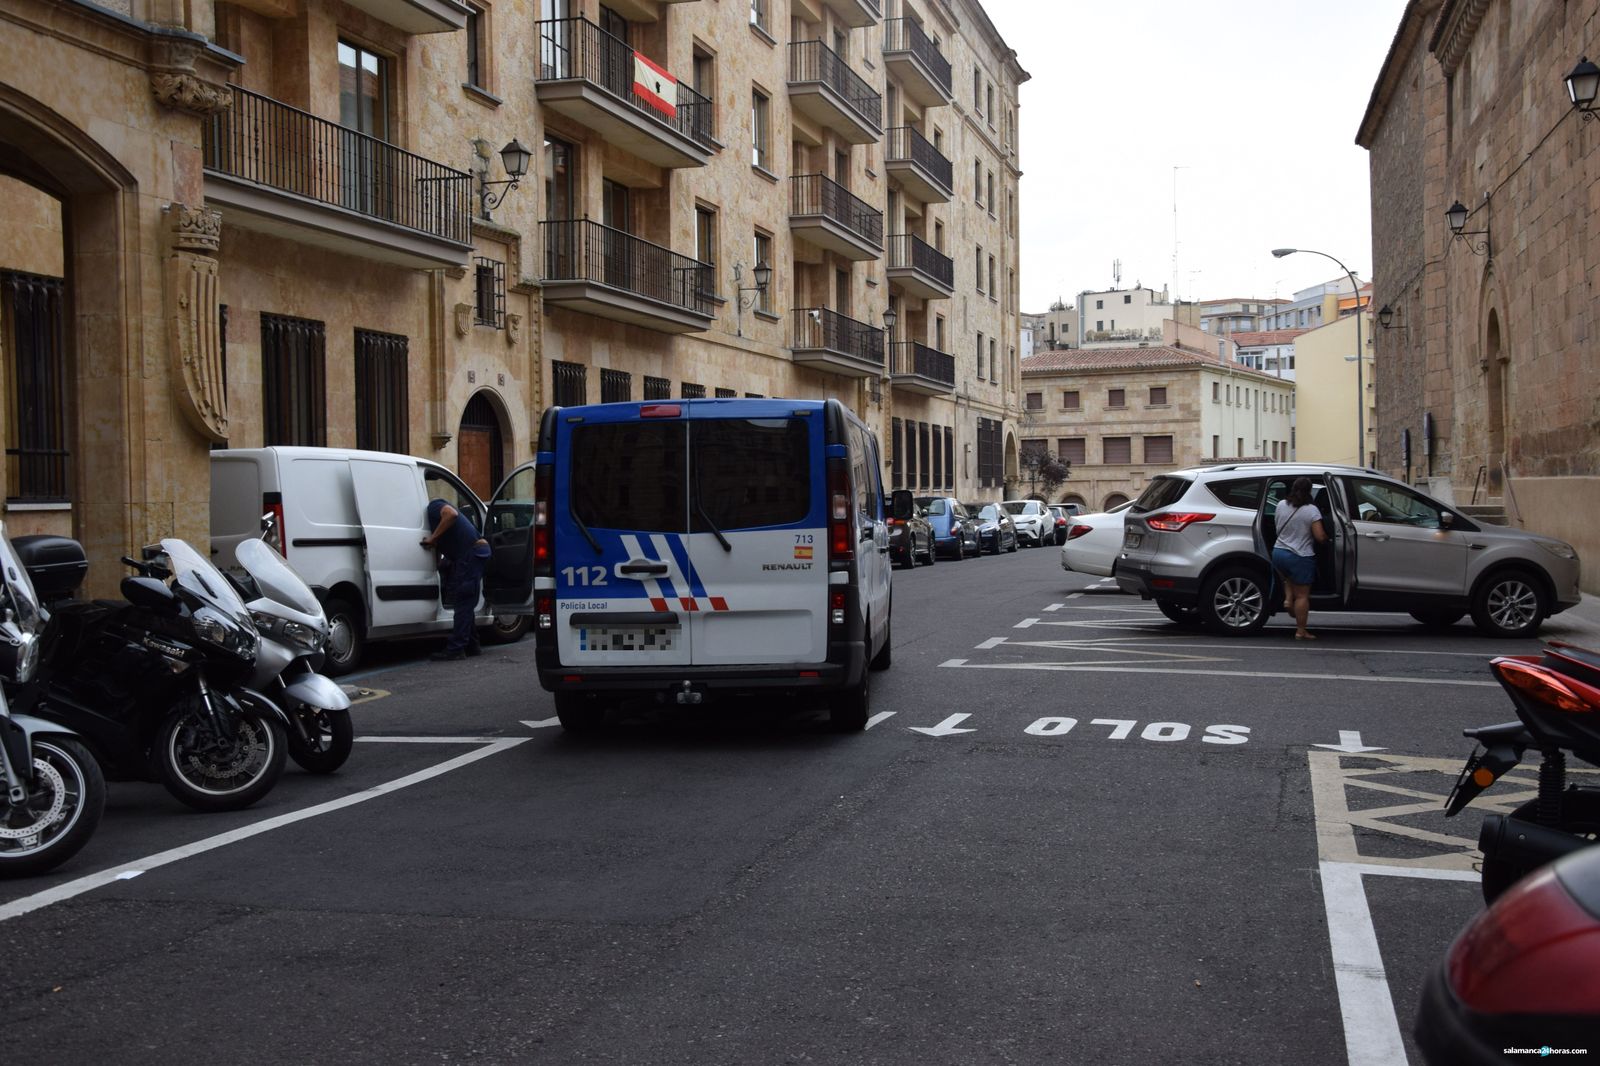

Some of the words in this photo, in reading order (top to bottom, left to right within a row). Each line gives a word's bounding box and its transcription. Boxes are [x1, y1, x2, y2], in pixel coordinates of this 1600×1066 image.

[795, 534, 814, 544] 713
[762, 562, 814, 571] RENAULT
[561, 566, 608, 586] 112
[588, 601, 608, 610] Local
[143, 637, 185, 657] Kawasaki
[1023, 716, 1251, 745] SOLO
